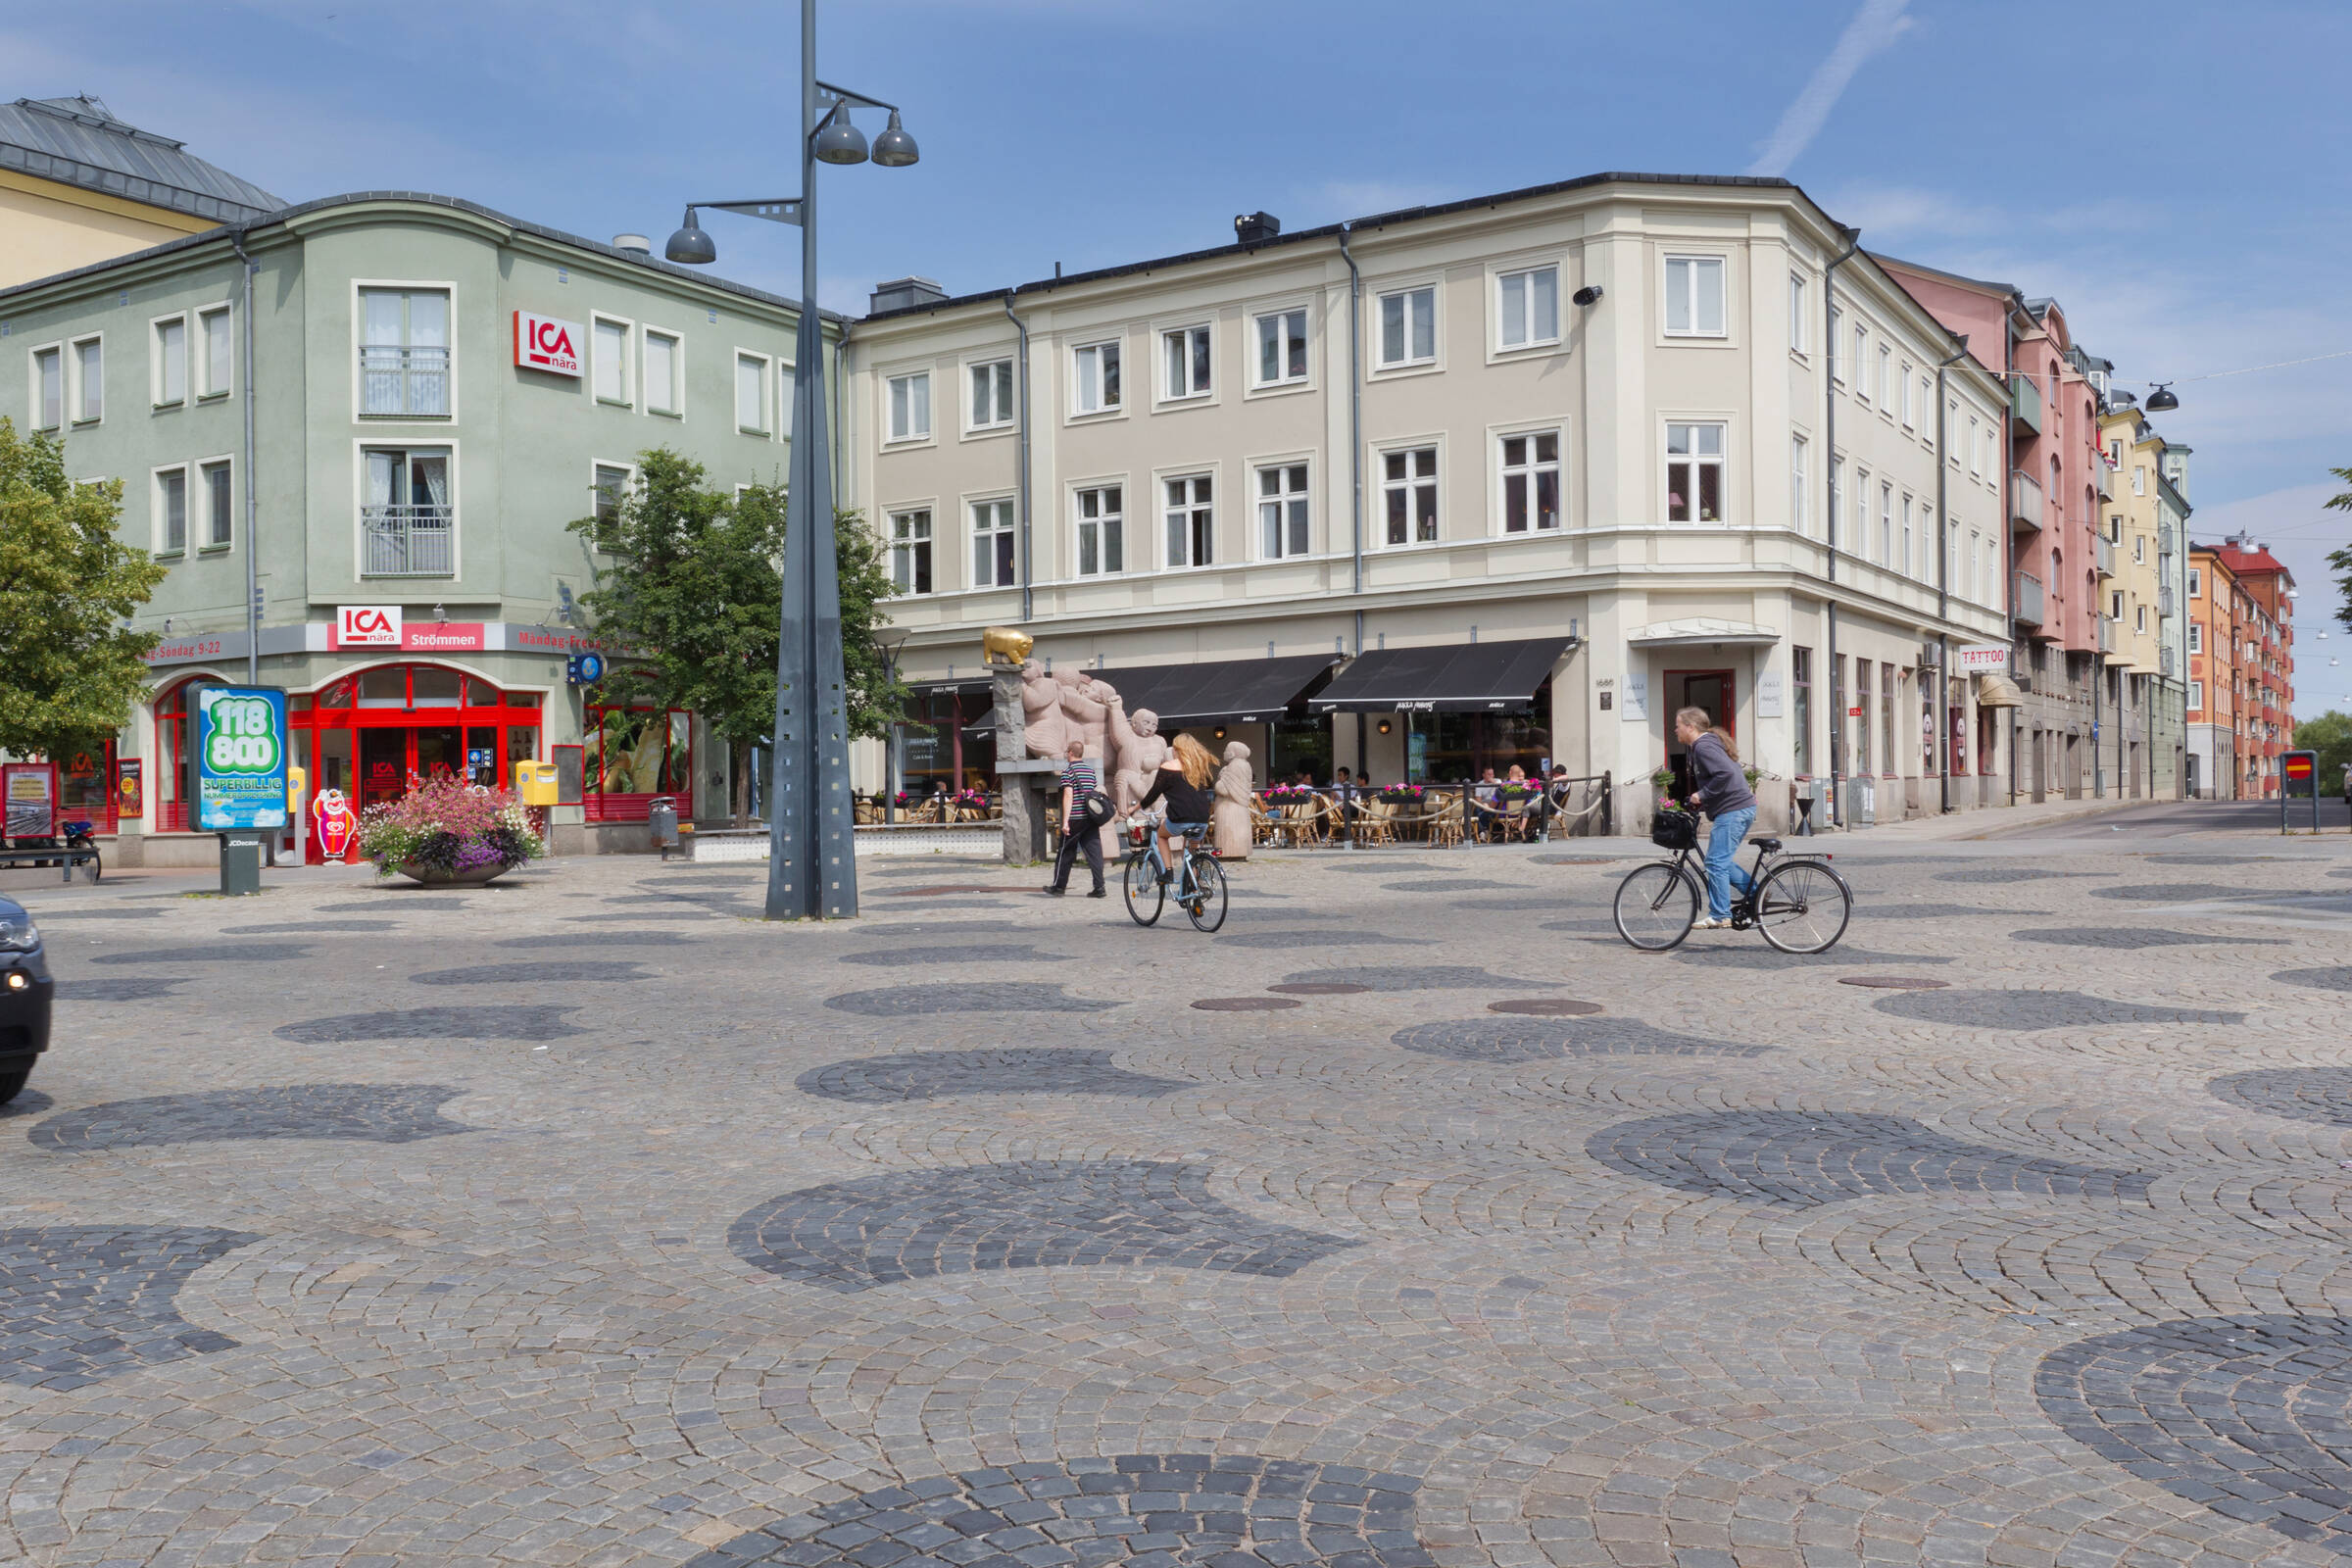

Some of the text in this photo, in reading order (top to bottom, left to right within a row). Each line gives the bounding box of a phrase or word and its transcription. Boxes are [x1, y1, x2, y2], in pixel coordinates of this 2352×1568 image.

[529, 318, 576, 359] ICA
[552, 357, 577, 370] nära
[346, 610, 394, 633] ICA
[368, 633, 395, 642] nära
[412, 634, 475, 646] Strömmen
[198, 640, 220, 656] 9-22
[1962, 649, 2005, 664] TATTOO
[217, 705, 268, 736] 118
[212, 736, 272, 766] 800
[372, 761, 396, 773] ICA
[204, 777, 282, 790] SUPERBILLIG
